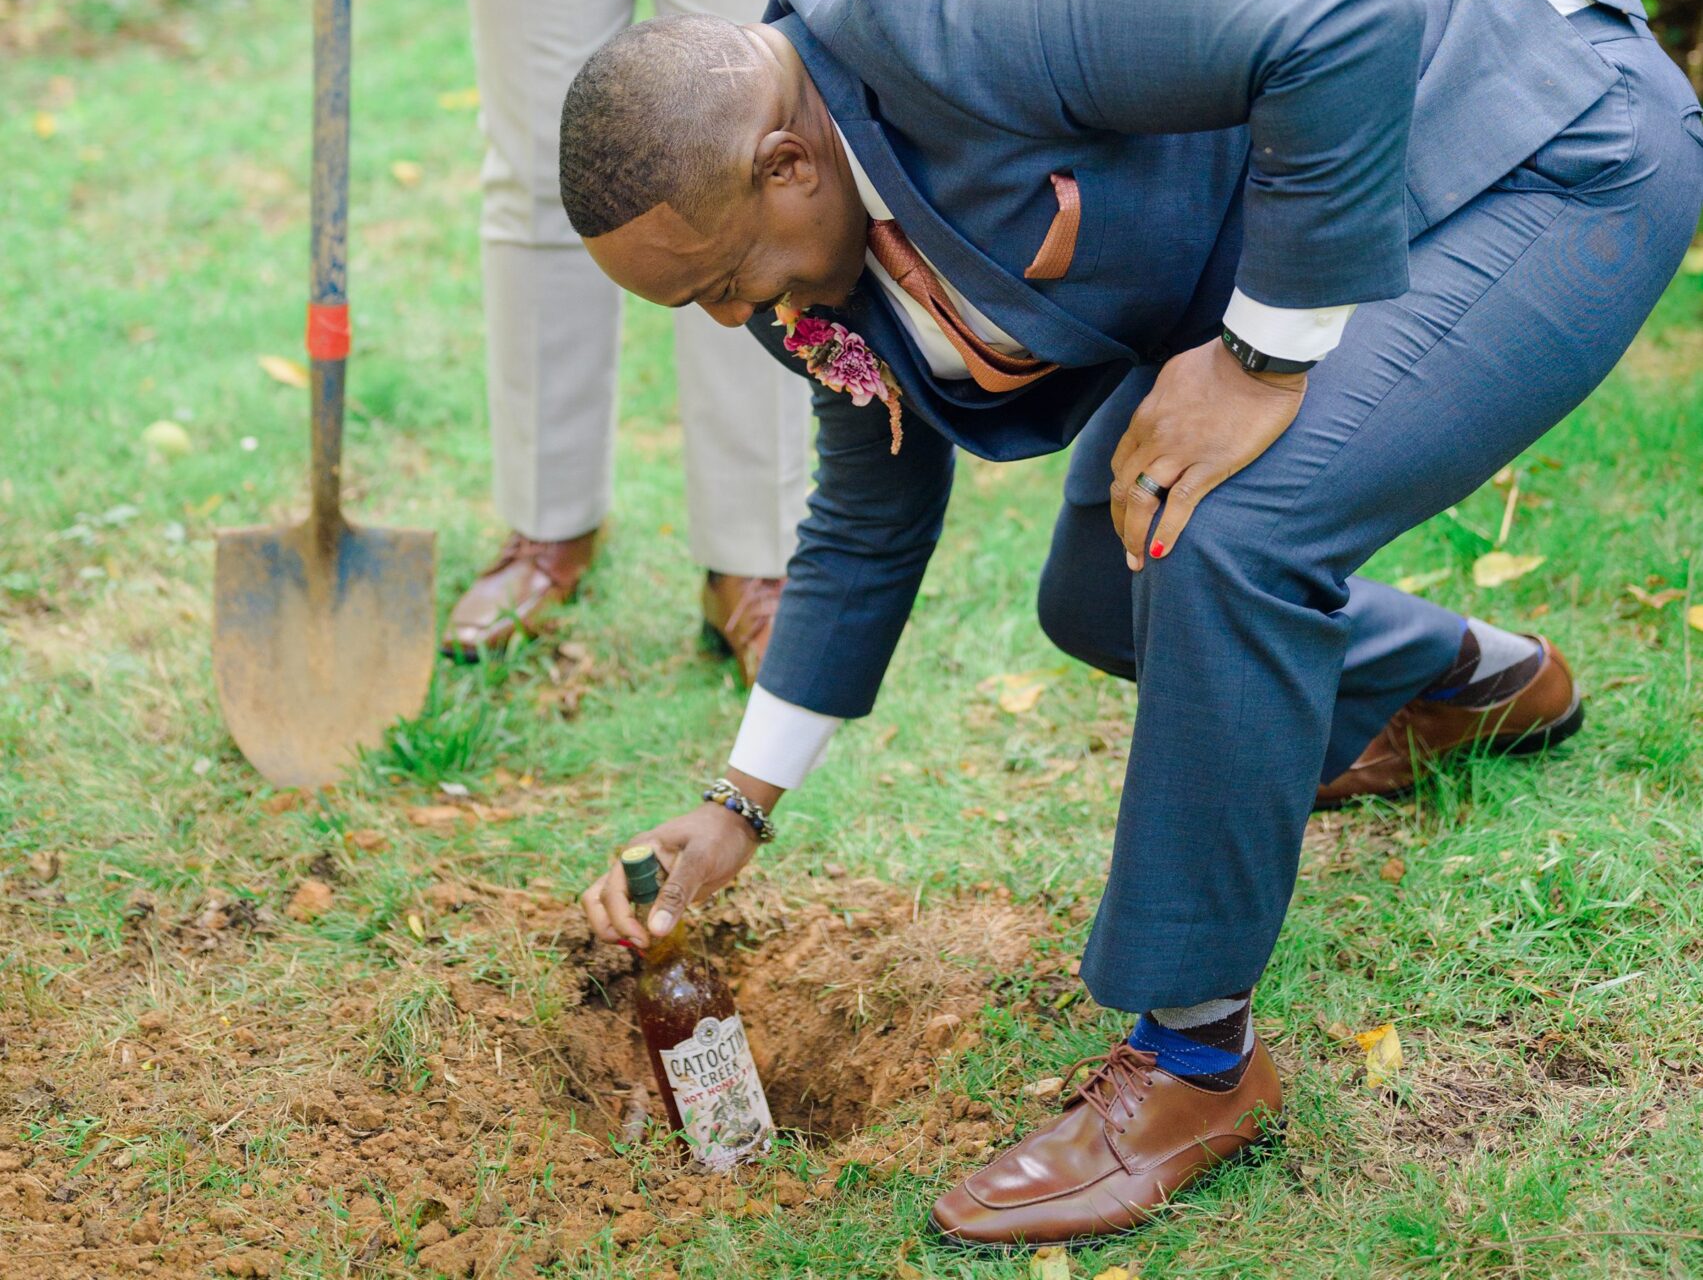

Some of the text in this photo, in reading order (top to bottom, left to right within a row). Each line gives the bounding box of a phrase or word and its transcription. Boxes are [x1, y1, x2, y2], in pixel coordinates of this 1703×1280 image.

[700, 1058, 740, 1088] CREEK
[682, 1075, 740, 1106] HOT HONEY
